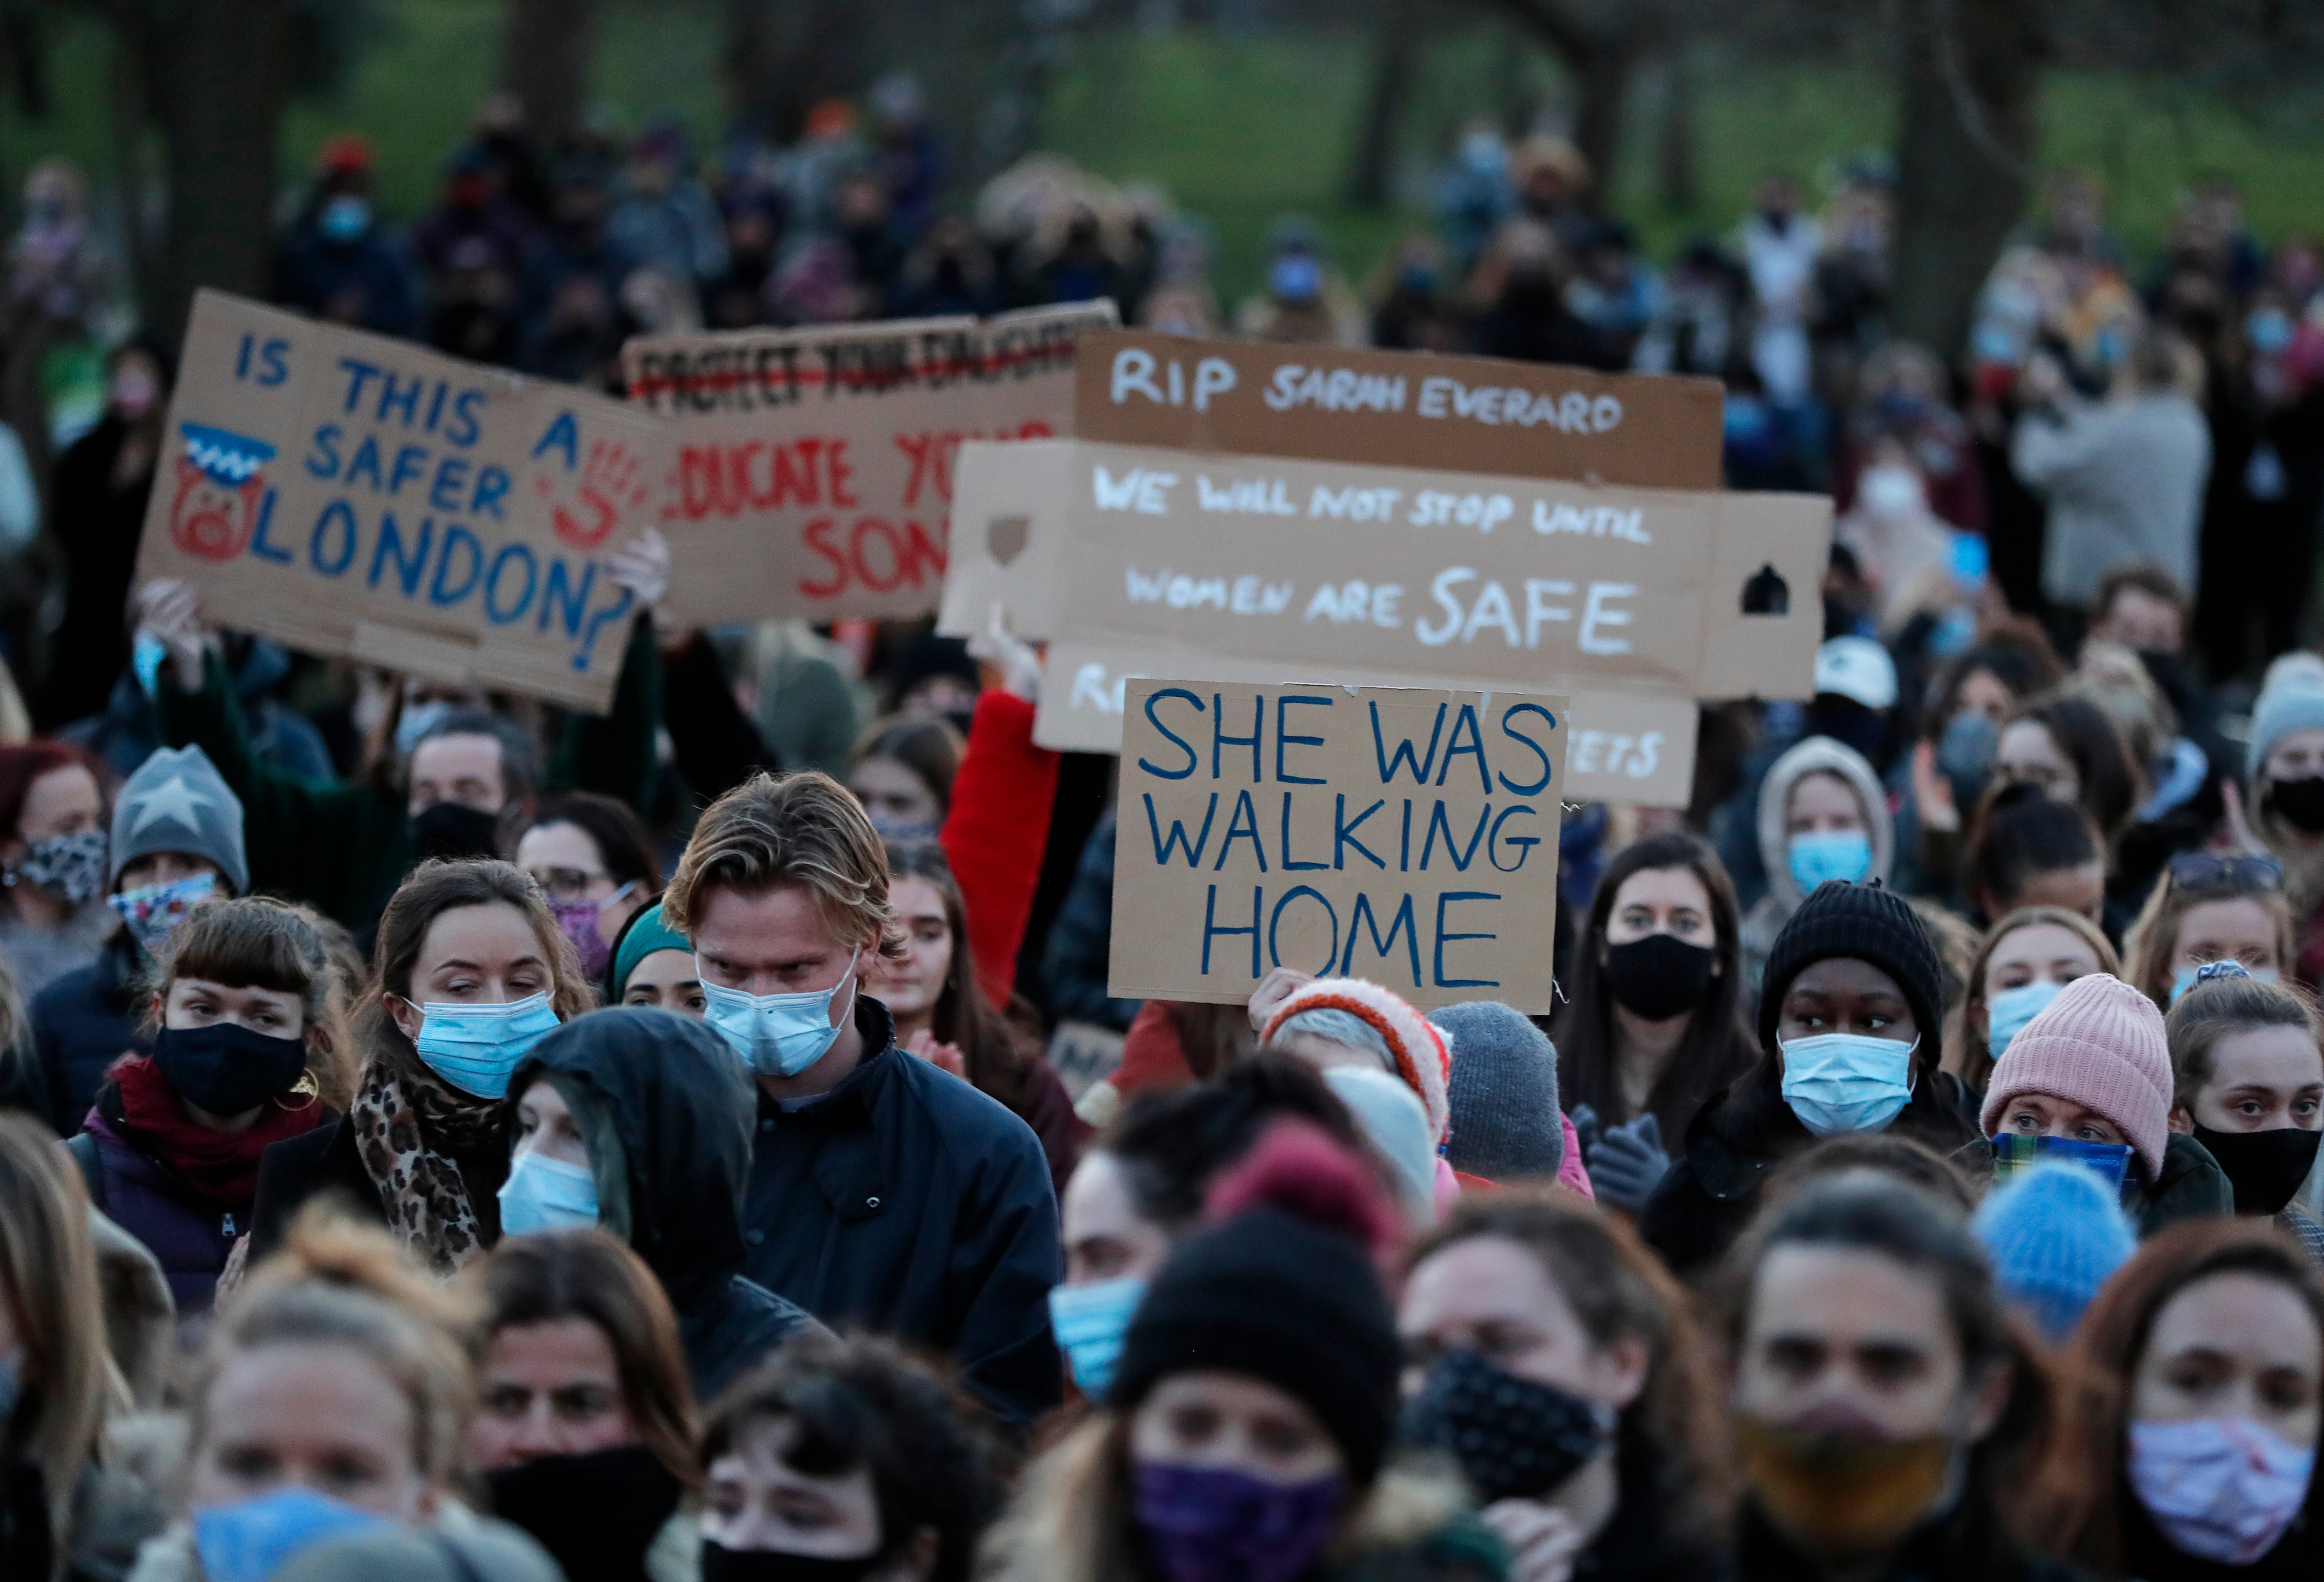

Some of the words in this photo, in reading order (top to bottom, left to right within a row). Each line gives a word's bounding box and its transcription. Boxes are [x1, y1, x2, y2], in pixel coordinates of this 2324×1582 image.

[235, 333, 293, 388] IS
[337, 358, 488, 449] THIS
[531, 411, 578, 469] A
[1111, 347, 1237, 413] RIP
[1263, 365, 1406, 412] SARAH
[1418, 377, 1624, 435] EVERARD
[305, 424, 511, 520] SAFER
[1093, 464, 1179, 515] WE
[1195, 474, 1297, 516] WILL
[1307, 485, 1401, 522] NOT
[1408, 488, 1513, 533] STOP
[1532, 499, 1652, 545] UNTIL
[247, 489, 637, 671] LONDON?
[1126, 565, 1294, 615] WOMEN
[1304, 580, 1405, 628] ARE
[1415, 565, 1640, 655] SAFE
[1138, 688, 1333, 785] SHE
[1369, 700, 1556, 796] WAS
[1142, 789, 1541, 873] WALKING
[1201, 885, 1501, 988] HOME
